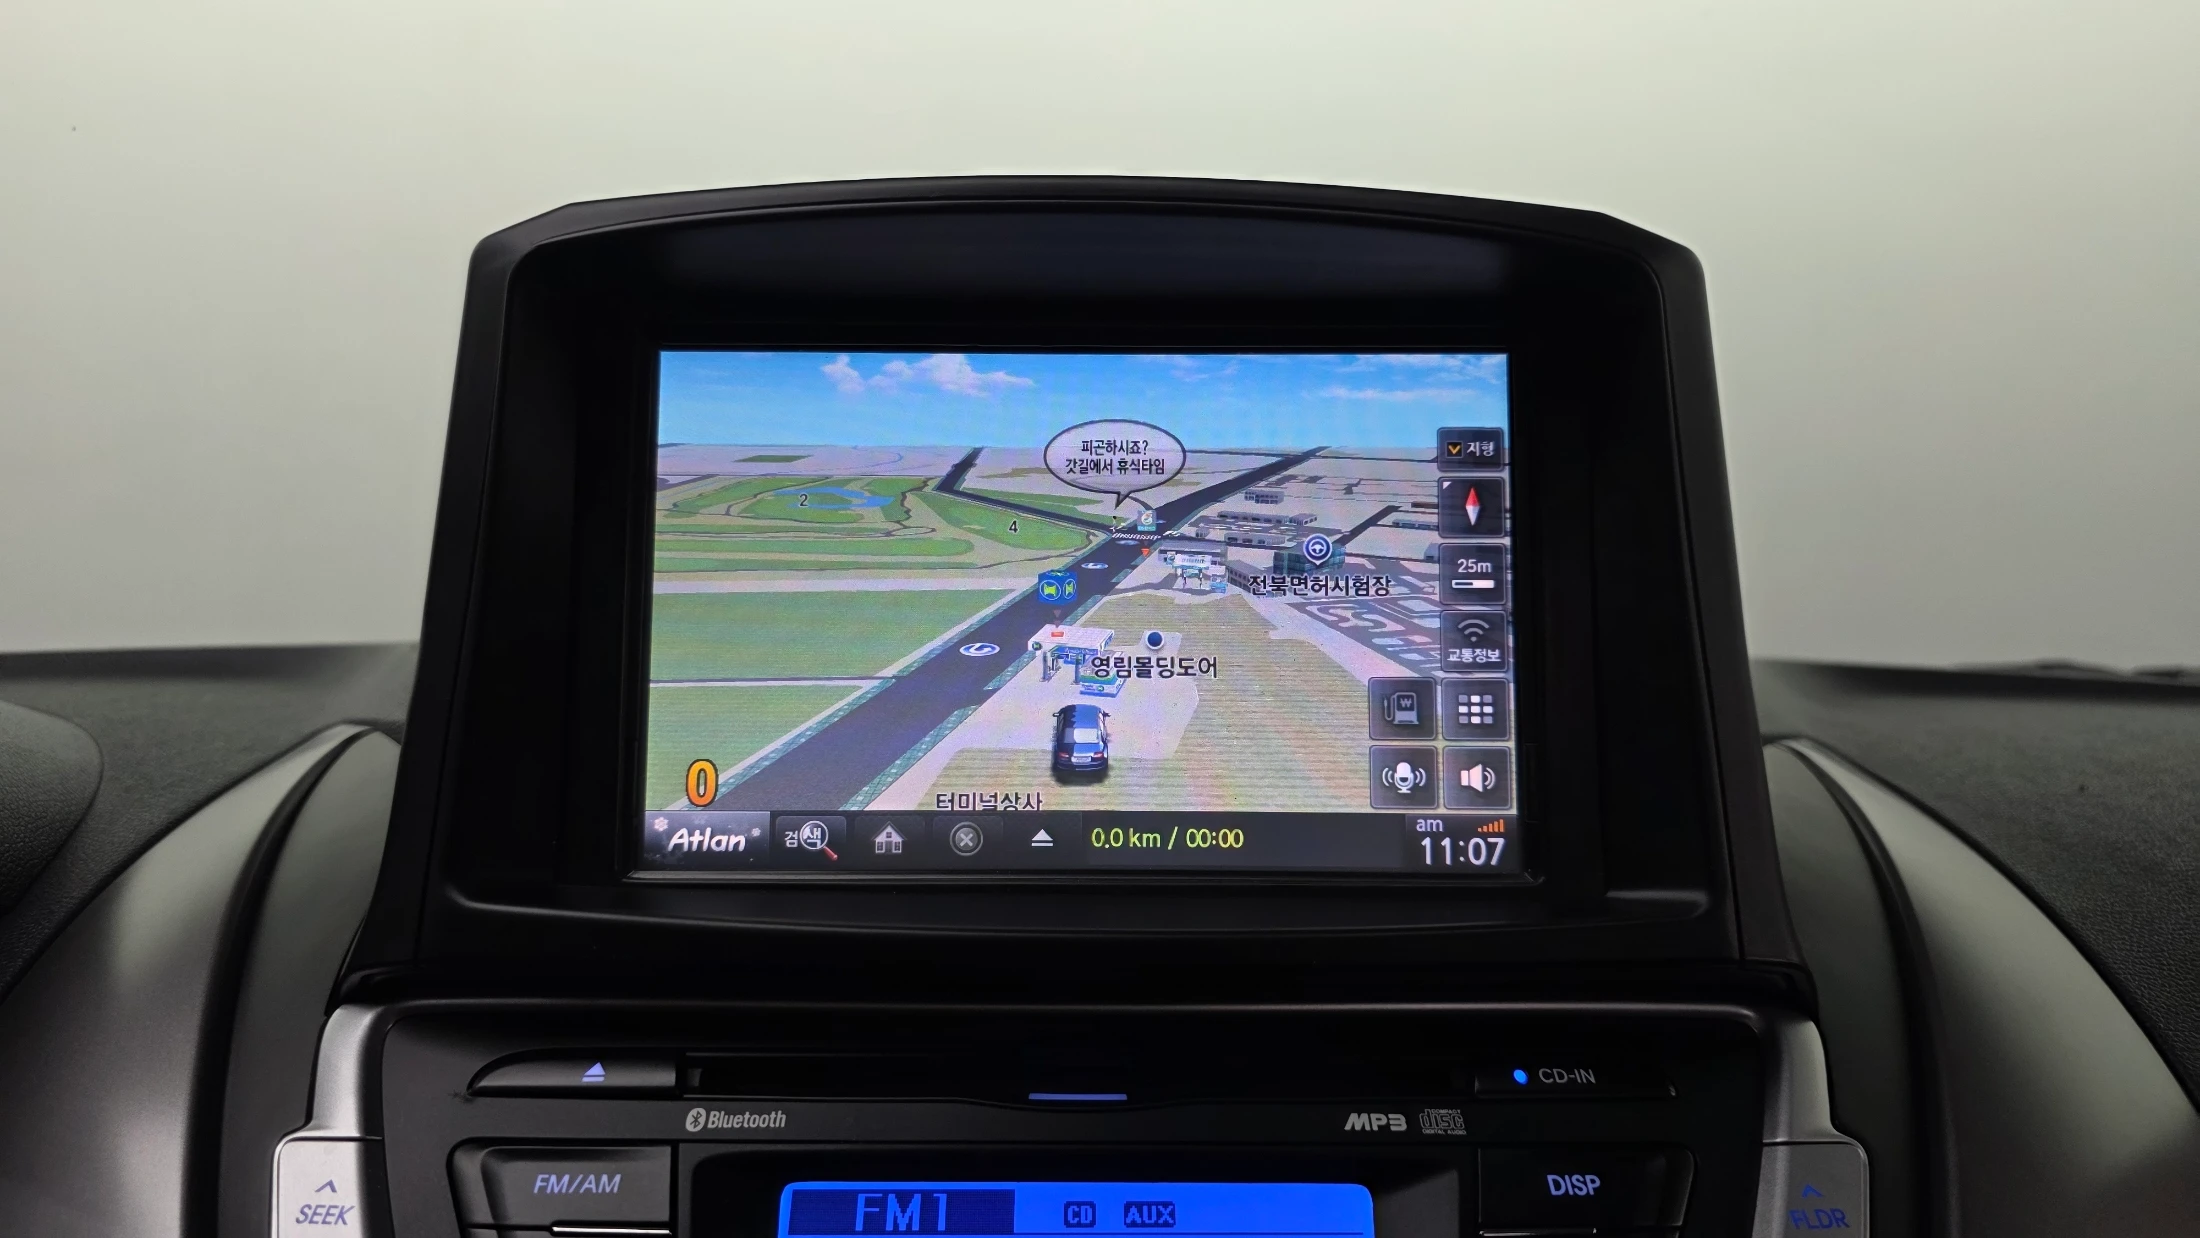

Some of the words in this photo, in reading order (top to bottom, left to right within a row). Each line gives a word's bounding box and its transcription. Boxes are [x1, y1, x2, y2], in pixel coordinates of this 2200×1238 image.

[1081, 439, 1149, 456] 피곤하시죠?
[1466, 441, 1495, 457] 지형
[1065, 458, 1113, 475] 갓길에서
[1117, 457, 1165, 475] 휴식타임
[799, 493, 808, 507] 2
[1008, 519, 1019, 534] 4
[1457, 559, 1492, 573] 25m
[1249, 574, 1392, 597] 전북면허시험장
[1446, 648, 1502, 663] 교통정보
[1091, 656, 1218, 678] 영림몰딩도어
[686, 759, 718, 807] 0
[936, 791, 1043, 811] 터미널상사
[1416, 818, 1444, 832] am
[667, 827, 746, 852] Atlan
[784, 827, 822, 848] 검색
[1091, 828, 1124, 849] 0.0
[1130, 828, 1161, 848] km
[1168, 826, 1179, 850] /
[1186, 828, 1244, 848] 00:00
[1421, 837, 1506, 866] 11:07
[1539, 1069, 1597, 1084] CD-IN
[707, 1109, 787, 1130] Bluetooth
[1344, 1112, 1408, 1132] MP3
[533, 1174, 621, 1194] FM/AM
[1547, 1174, 1601, 1195] DISP
[295, 1204, 355, 1226] SEEK
[855, 1193, 948, 1231] FM1
[1067, 1204, 1093, 1224] CD
[1125, 1205, 1174, 1224] AUX
[1788, 1207, 1850, 1230] FLDR
